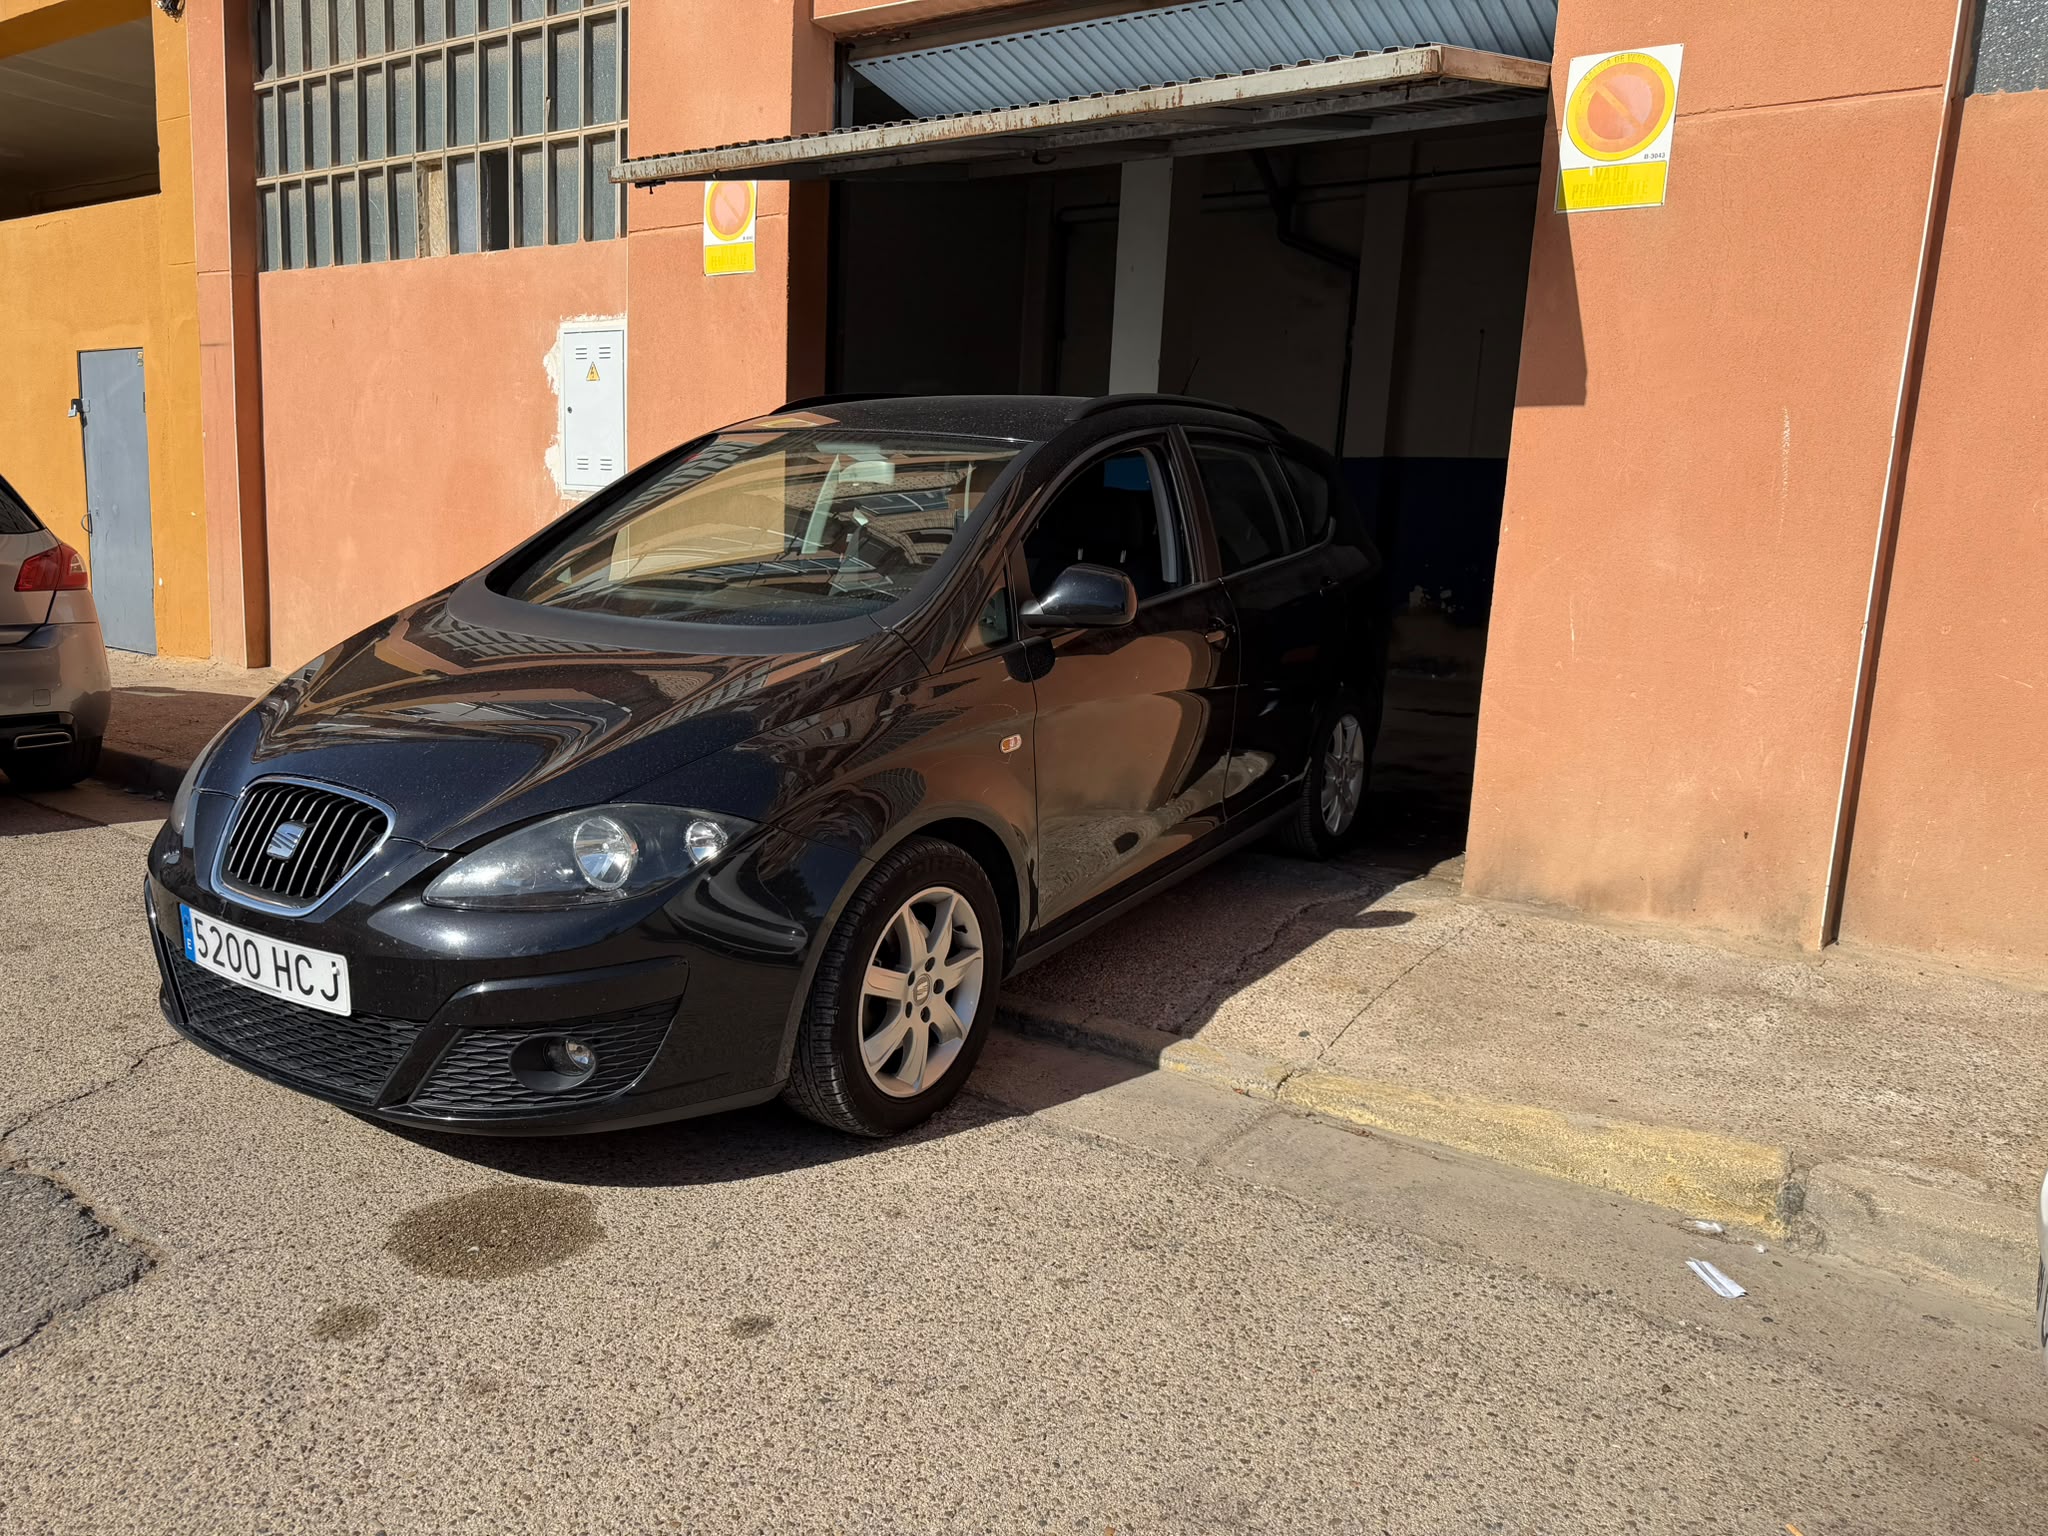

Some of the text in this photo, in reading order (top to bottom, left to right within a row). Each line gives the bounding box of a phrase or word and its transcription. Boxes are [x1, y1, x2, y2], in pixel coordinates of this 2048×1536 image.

[1595, 166, 1629, 182] VADO
[194, 917, 340, 1002] 5200 HCJ
